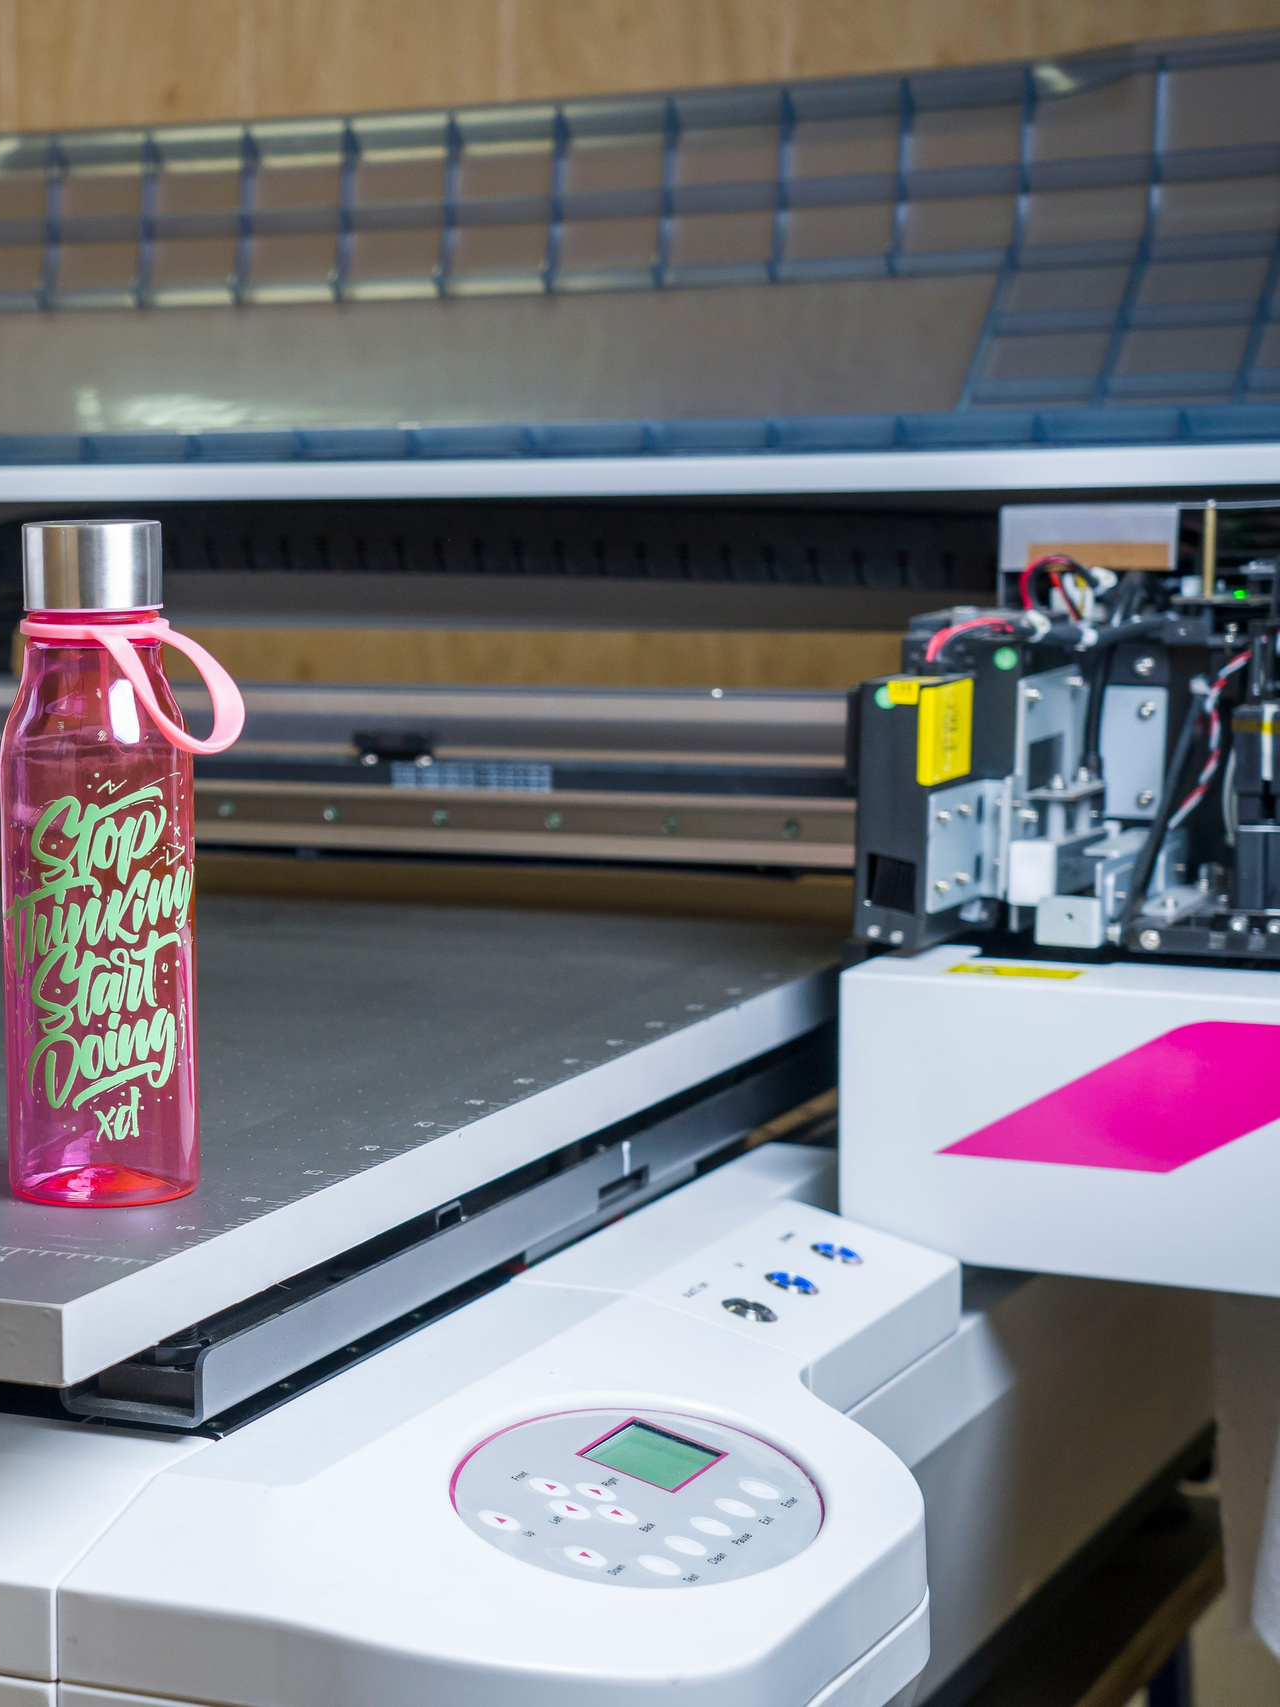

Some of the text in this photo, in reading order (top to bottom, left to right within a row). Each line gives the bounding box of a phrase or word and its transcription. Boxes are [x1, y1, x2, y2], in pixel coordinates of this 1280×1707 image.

[31, 929, 182, 1033] Start
[511, 1470, 530, 1482] Front
[600, 1476, 620, 1488] Right
[780, 1496, 799, 1508] Enter
[548, 1515, 565, 1525] Left
[758, 1515, 775, 1526] Exit
[521, 1530, 536, 1538] Up
[638, 1522, 657, 1535] Back
[731, 1532, 753, 1546] Pause
[706, 1552, 728, 1565] Clean
[606, 1564, 627, 1576] Down
[682, 1572, 700, 1584] Test
